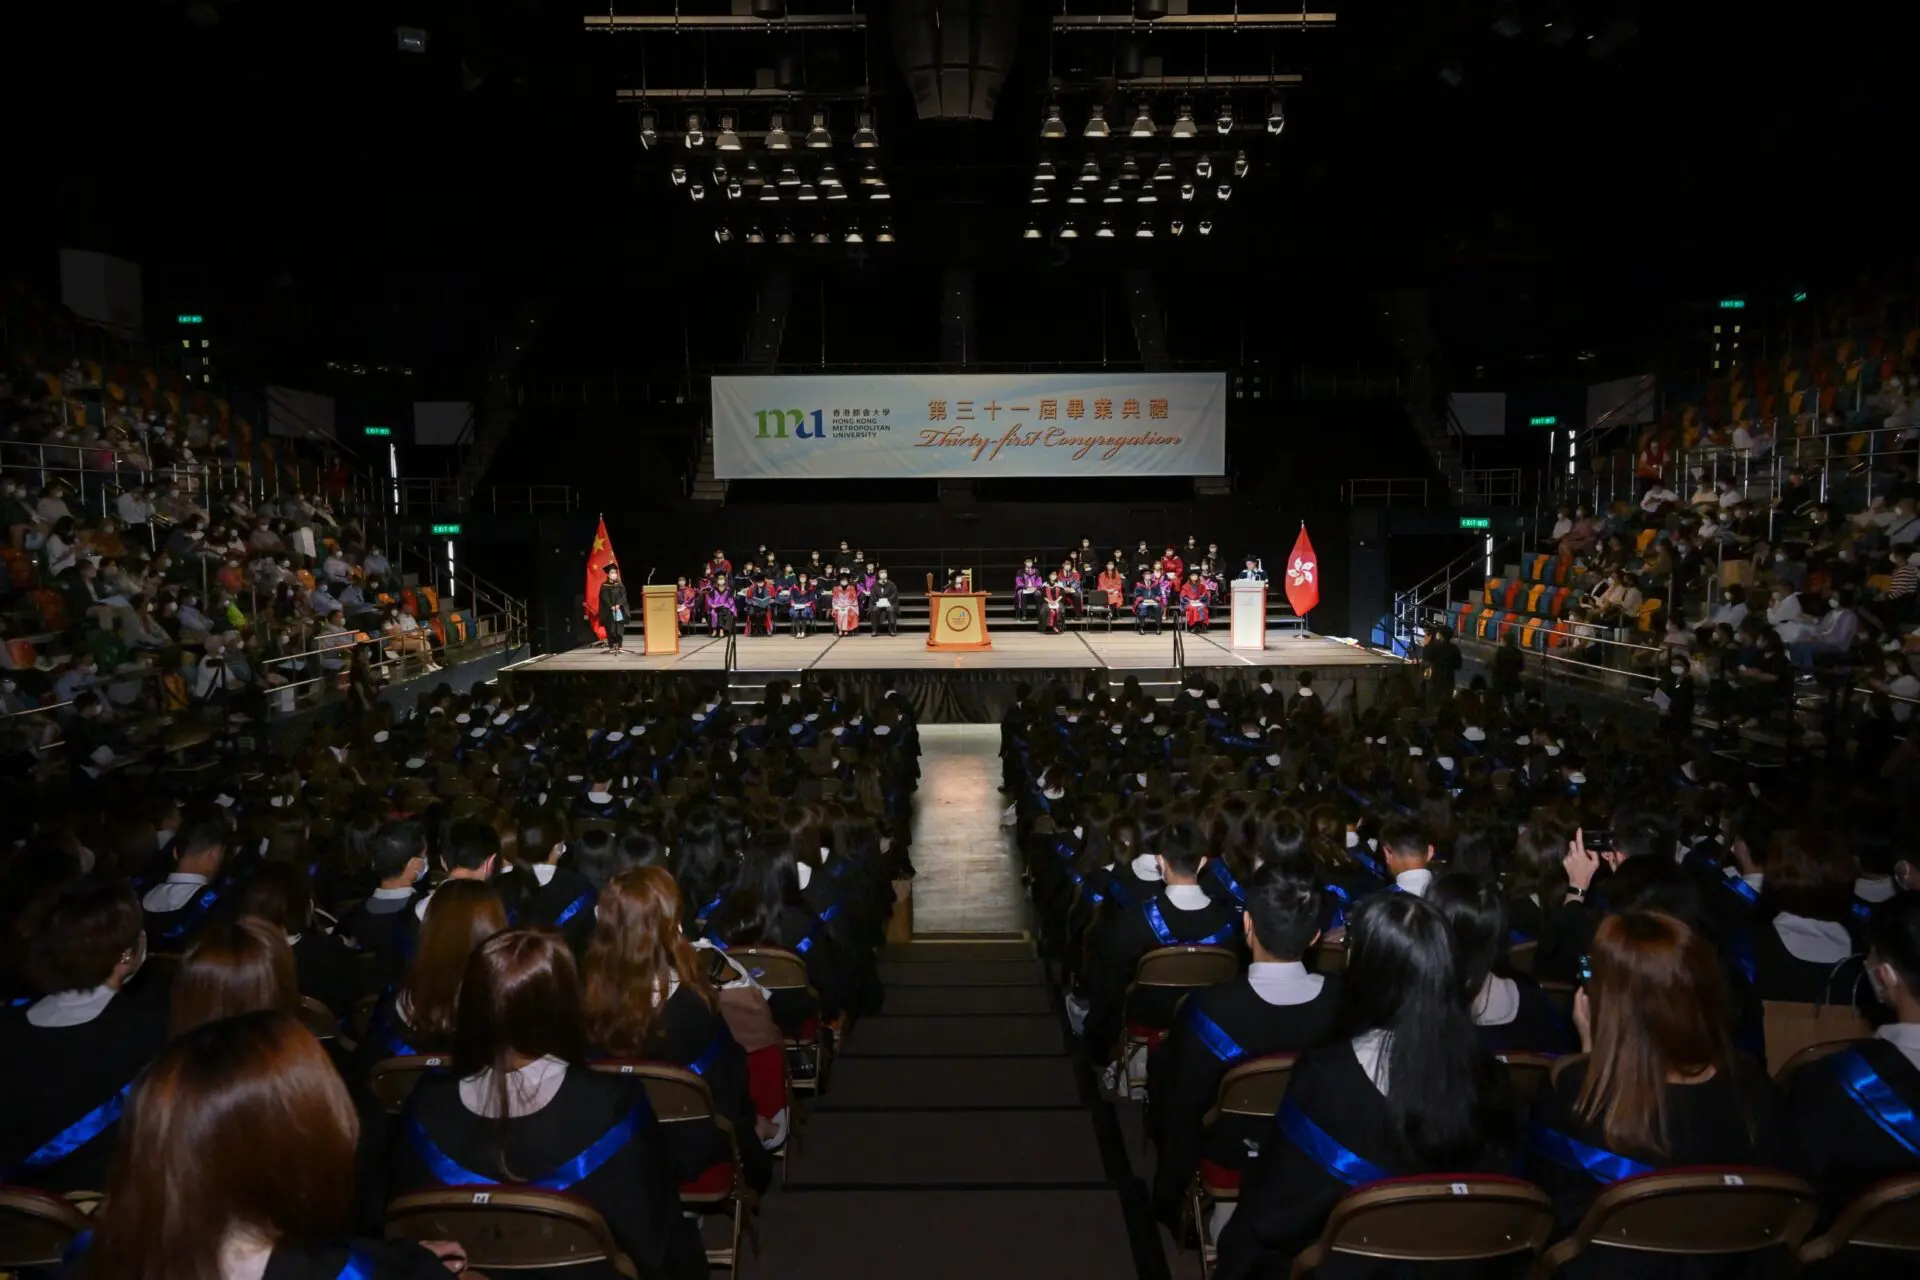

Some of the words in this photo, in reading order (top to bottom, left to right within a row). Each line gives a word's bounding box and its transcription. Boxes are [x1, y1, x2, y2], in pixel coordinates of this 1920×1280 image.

[833, 408, 890, 417] 香港都會大學
[928, 399, 1169, 421] 第三十一屆畢業典禮
[914, 423, 1042, 461] Thirty-first
[1043, 426, 1183, 461] Congregation
[1462, 519, 1476, 527] EXIT
